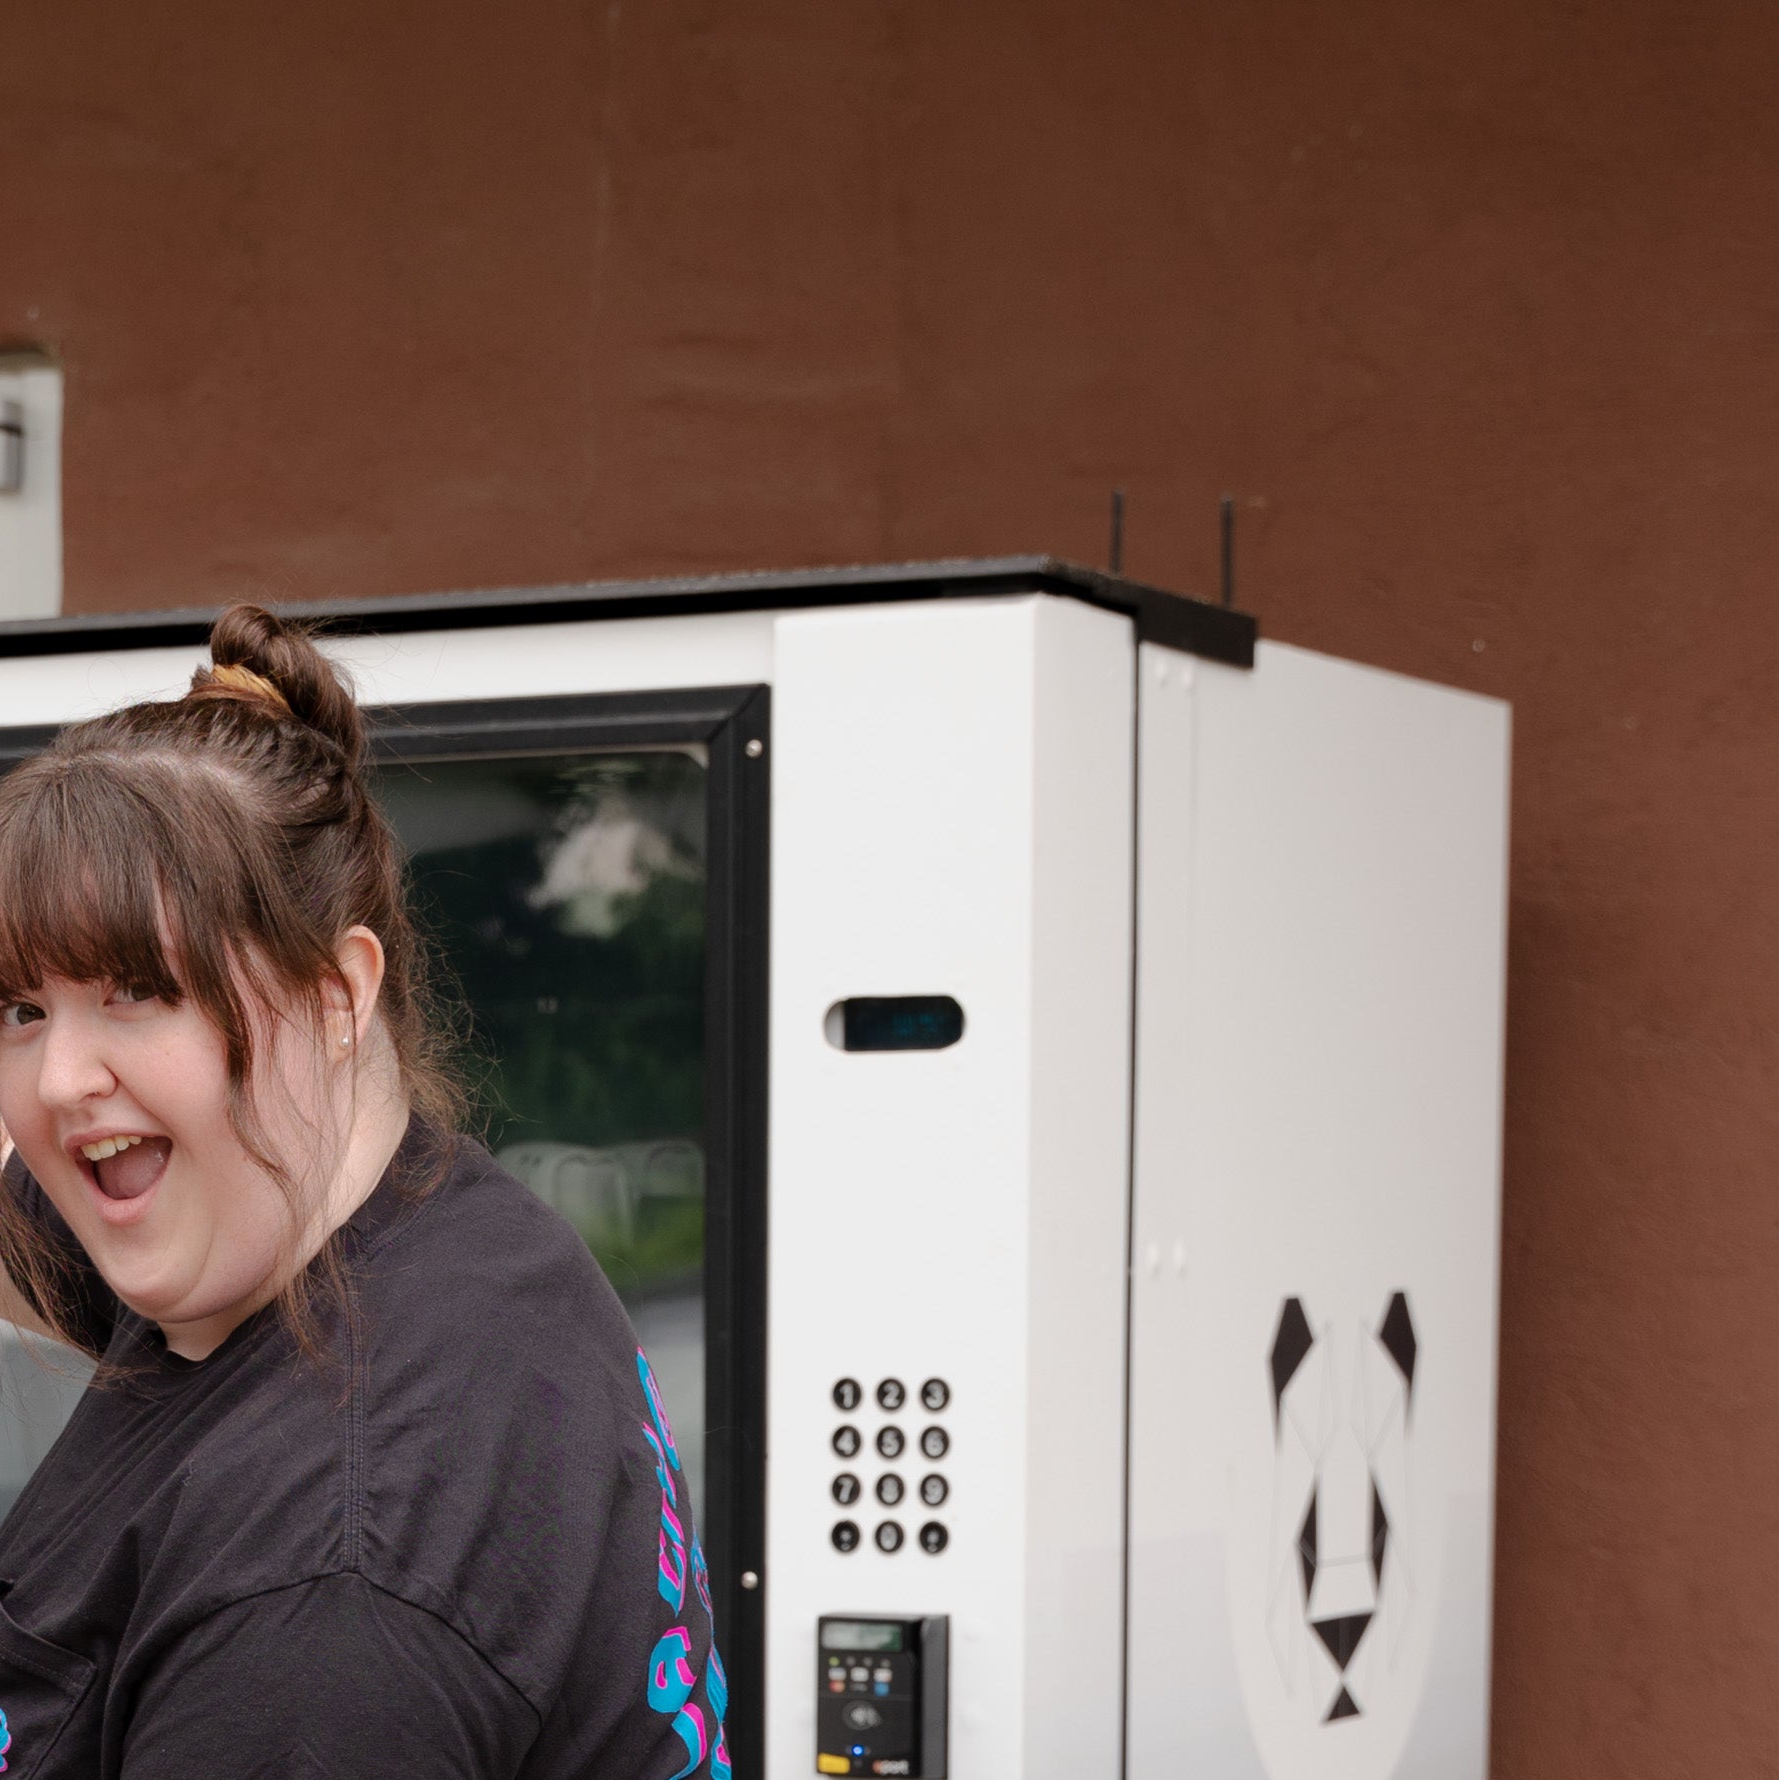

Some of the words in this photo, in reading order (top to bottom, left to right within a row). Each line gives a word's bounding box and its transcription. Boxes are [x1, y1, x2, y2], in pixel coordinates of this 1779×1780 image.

[882, 1383, 900, 1408] 2
[925, 1381, 945, 1408] 3
[836, 1429, 856, 1455] 4
[837, 1477, 854, 1504] 7
